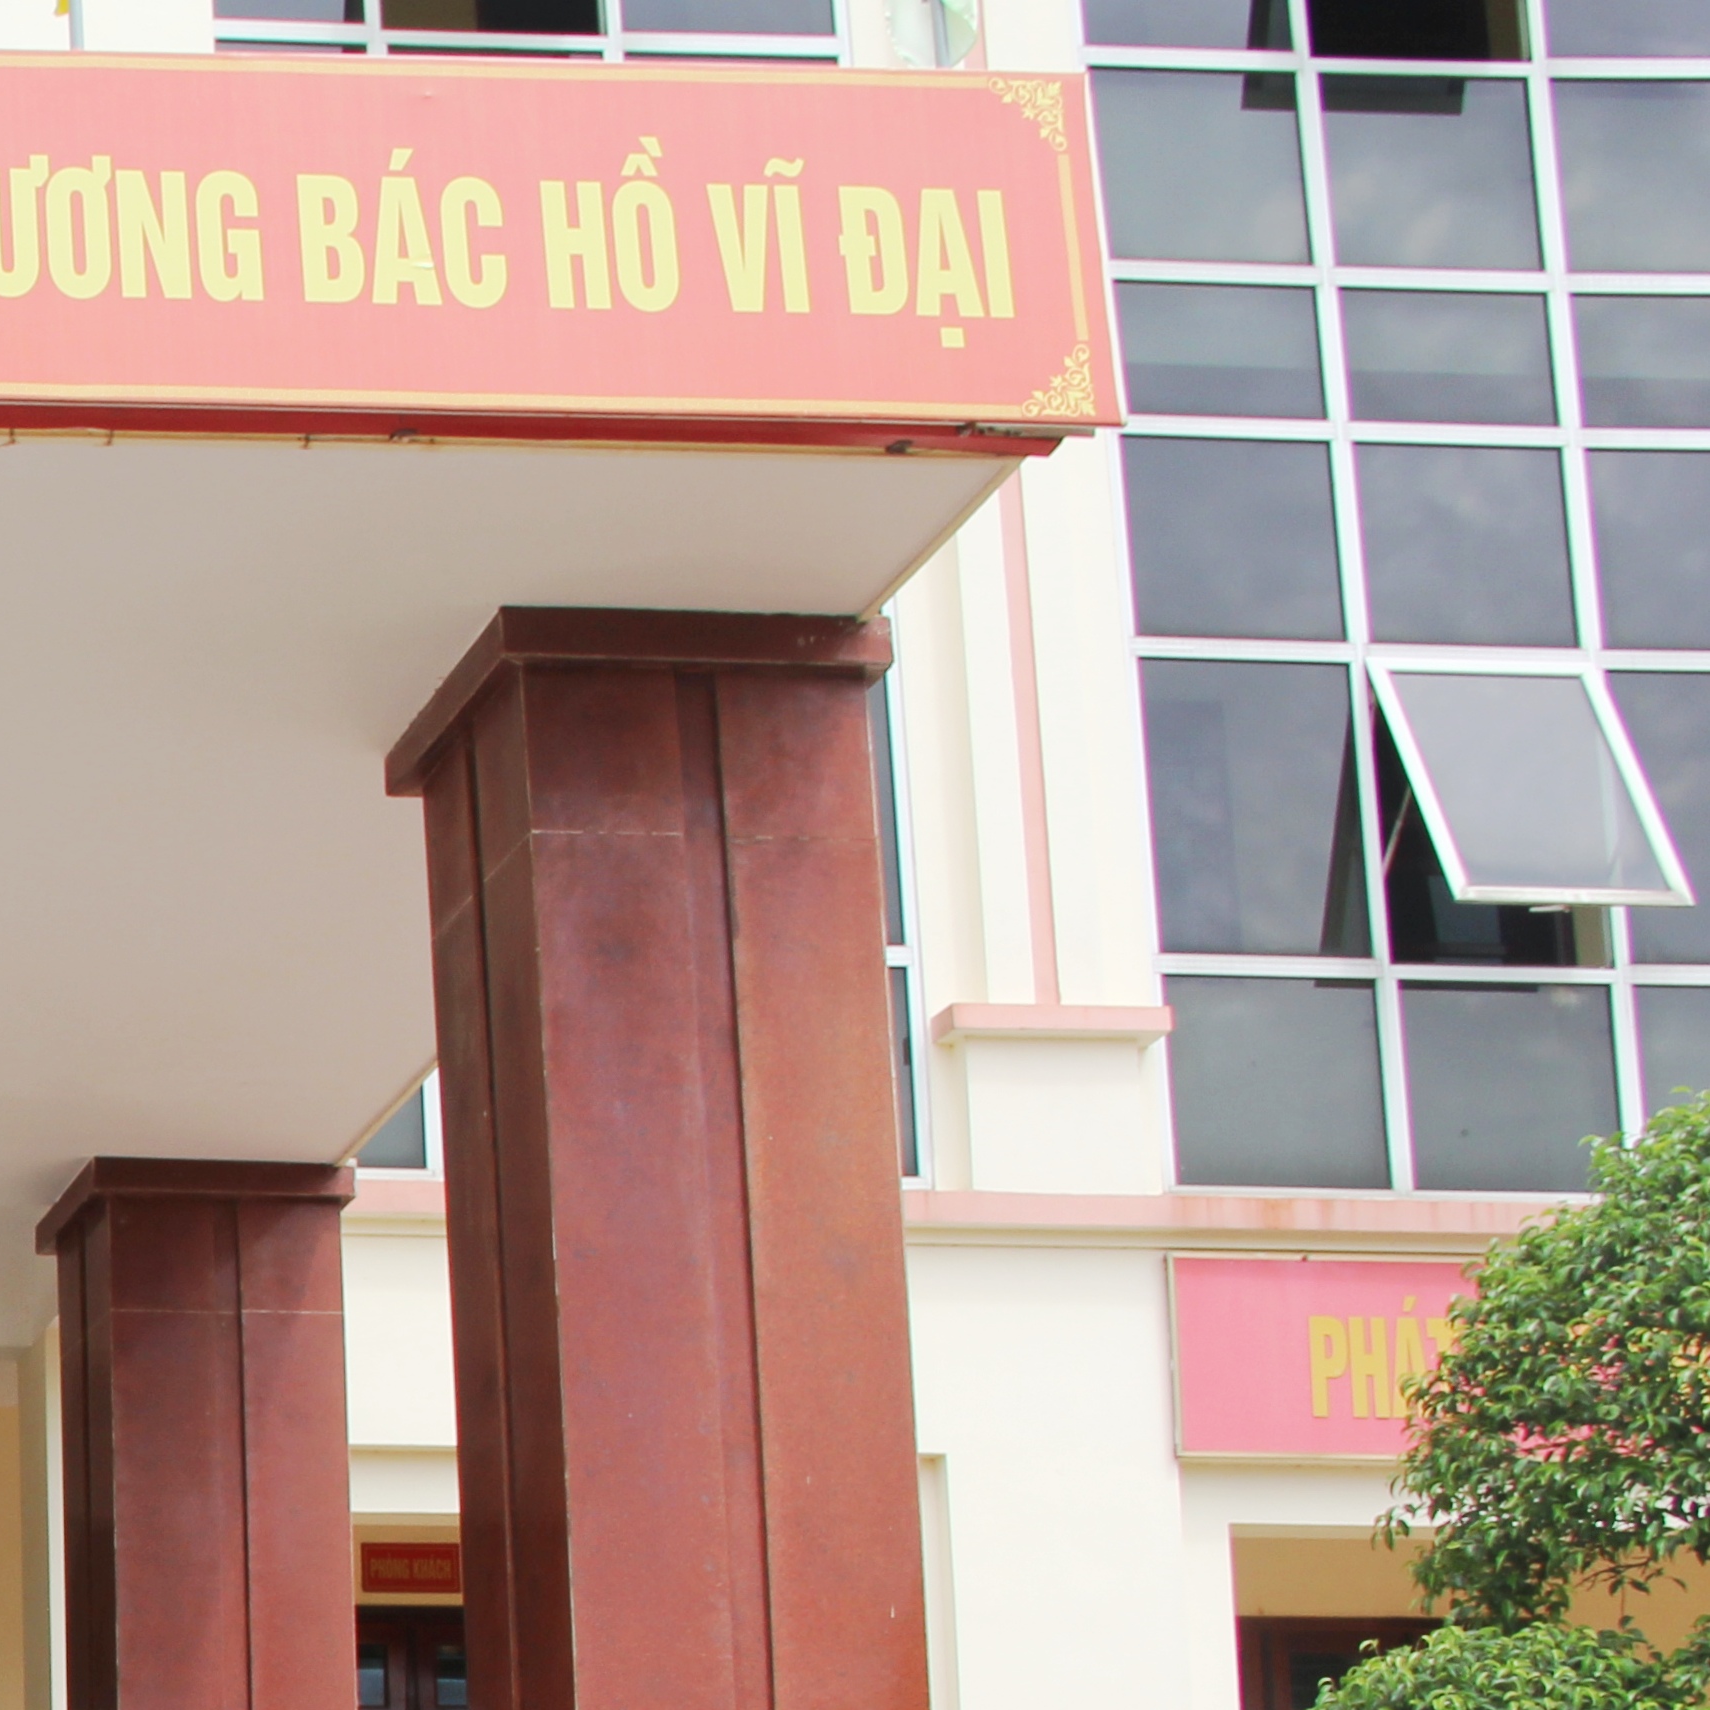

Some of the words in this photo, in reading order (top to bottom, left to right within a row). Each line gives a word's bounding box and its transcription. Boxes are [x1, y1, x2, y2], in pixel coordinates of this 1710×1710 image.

[297, 146, 510, 308] BÁC
[540, 134, 682, 312] HỒ
[707, 156, 813, 314] VĨ
[838, 184, 1018, 350] ĐẠI
